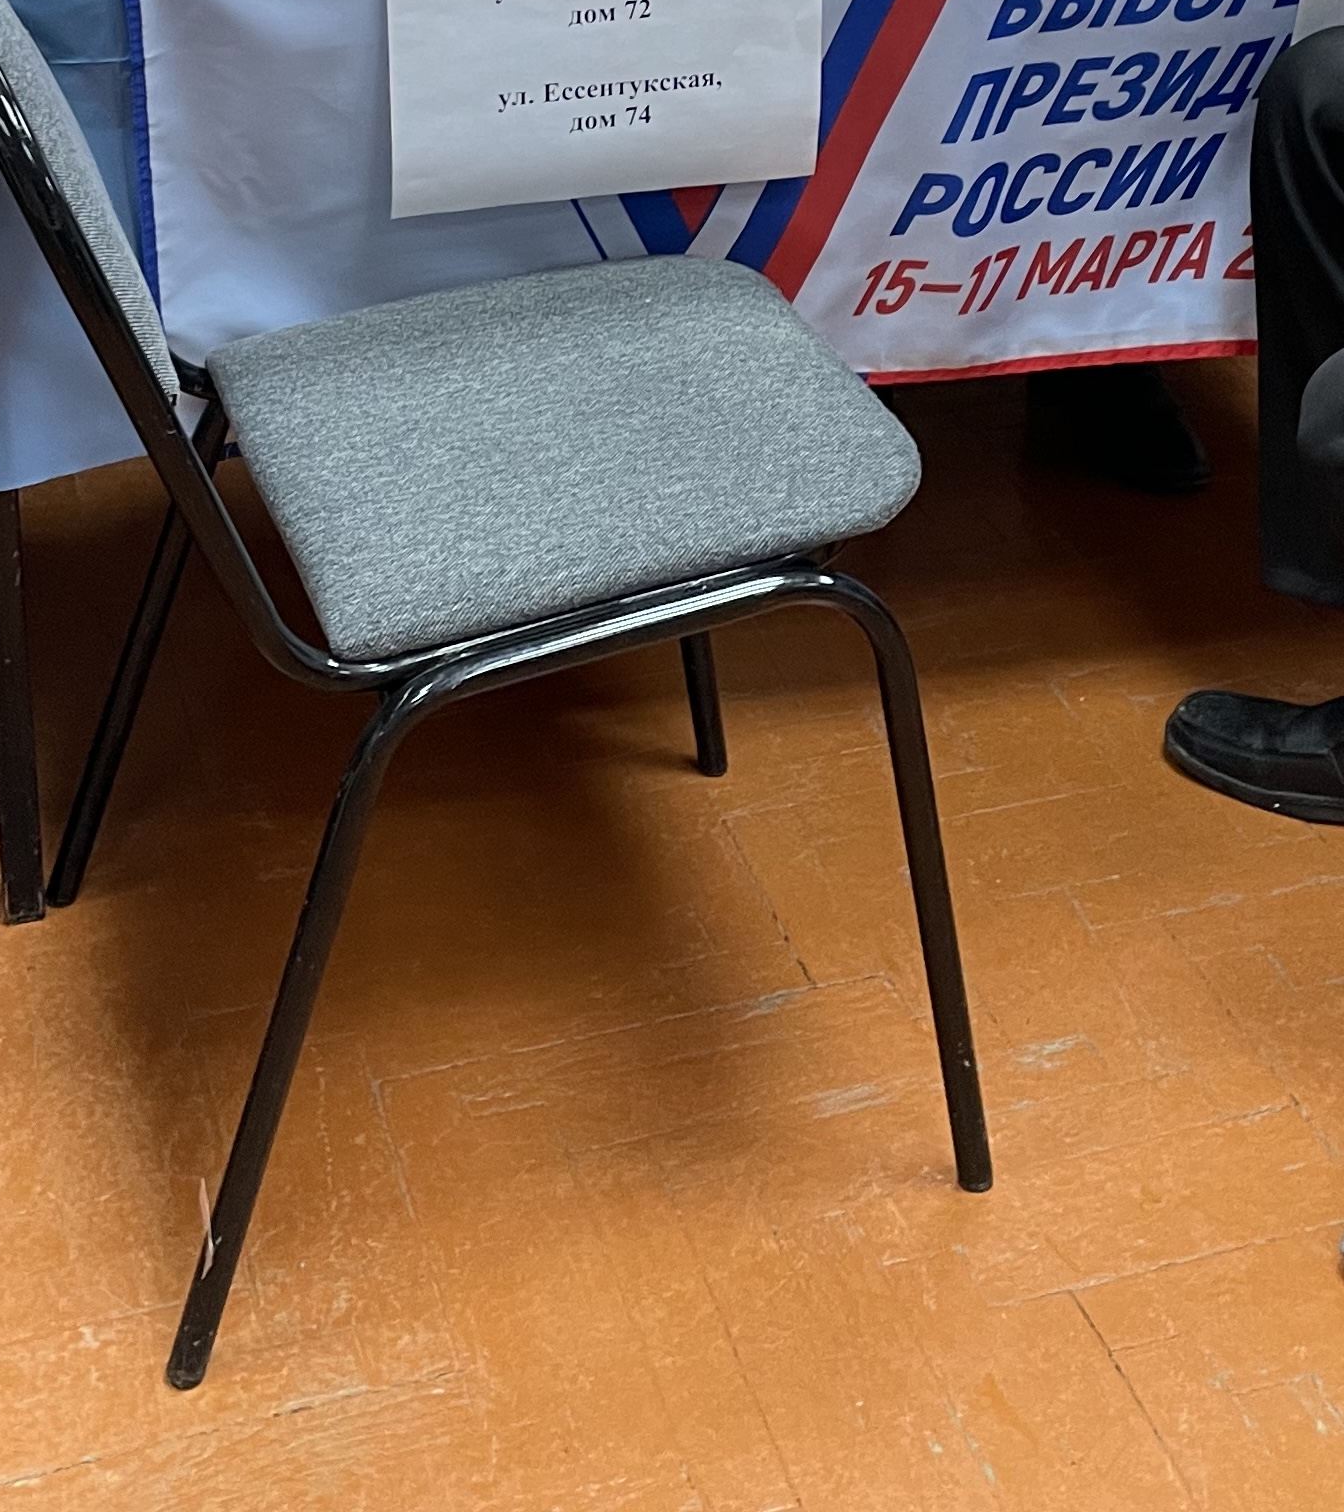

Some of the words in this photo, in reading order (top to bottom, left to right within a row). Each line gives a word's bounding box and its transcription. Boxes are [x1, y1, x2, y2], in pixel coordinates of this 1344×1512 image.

[568, 6, 616, 27] дом
[624, 0, 652, 20] 72
[498, 91, 534, 113] ул.
[543, 72, 722, 103] Ессентукская,
[940, 32, 1292, 144] ПРЕЗИД
[569, 112, 616, 133] дом
[625, 104, 652, 126] 74
[890, 133, 1227, 238] РОССИИ
[1016, 221, 1216, 300] МАРТА
